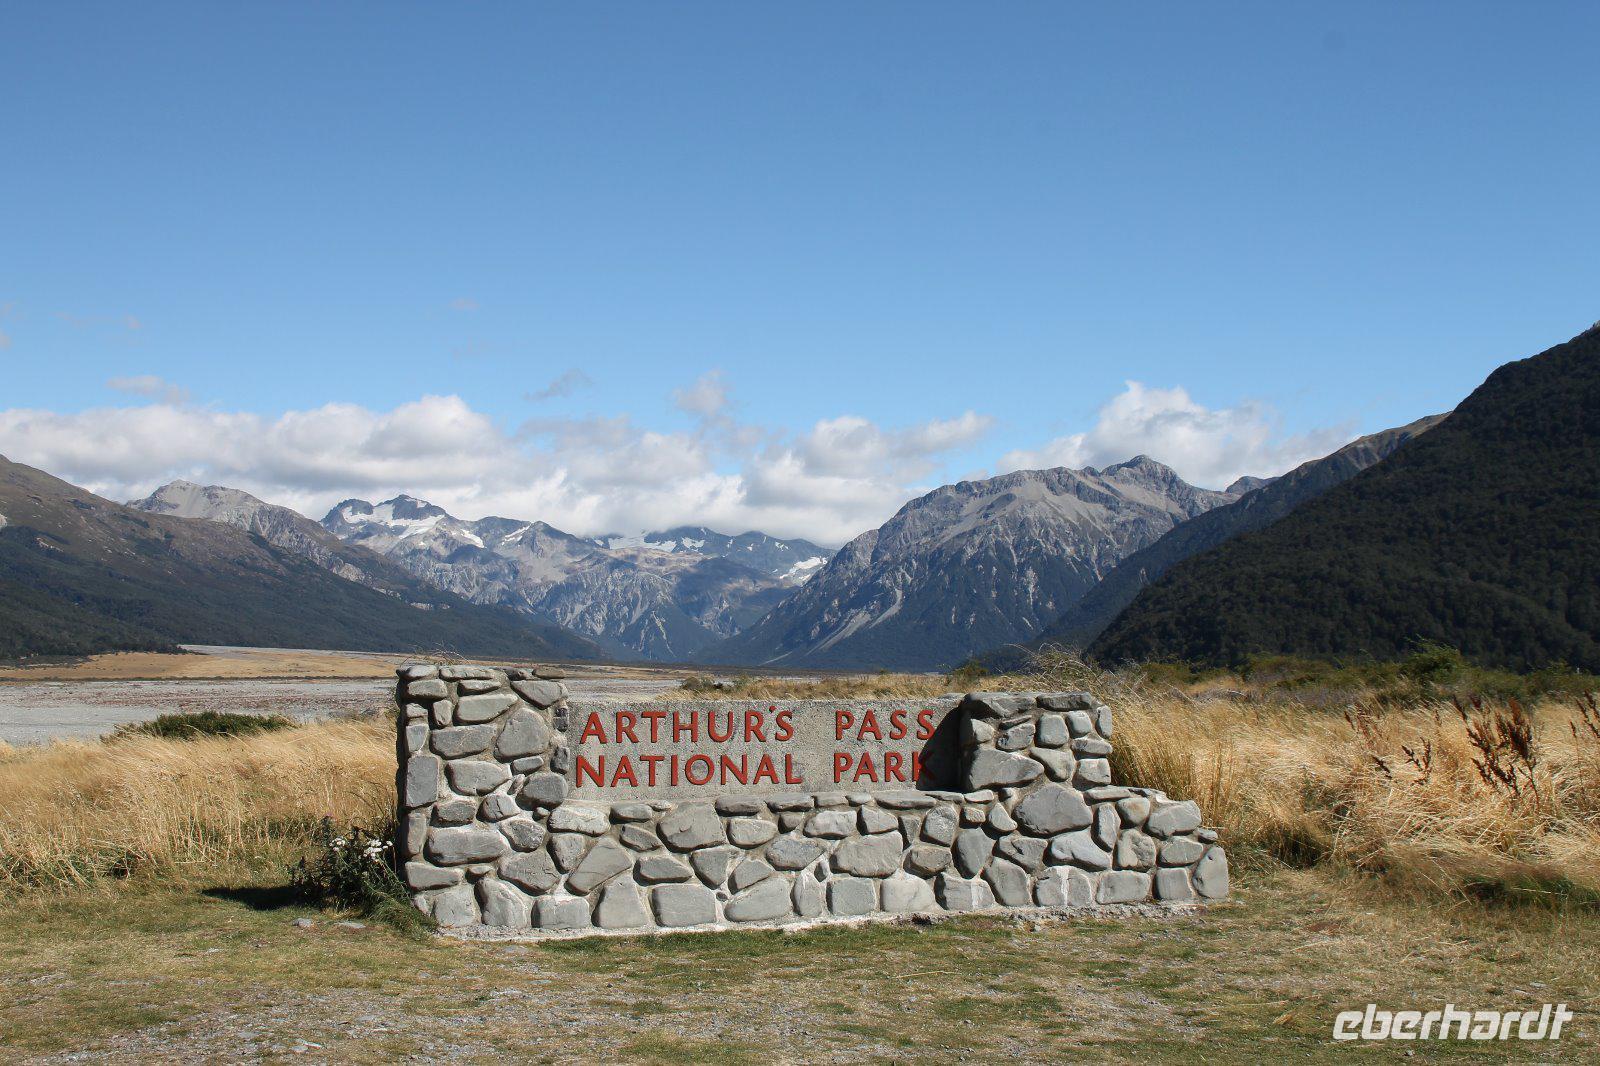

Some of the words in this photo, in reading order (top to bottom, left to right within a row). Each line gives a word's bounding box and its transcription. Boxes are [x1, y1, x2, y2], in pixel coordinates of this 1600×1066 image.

[580, 707, 795, 744] ARTHUR'S
[835, 709, 937, 742] PASS
[576, 753, 803, 788] NATIONAL
[833, 751, 936, 783] PARK
